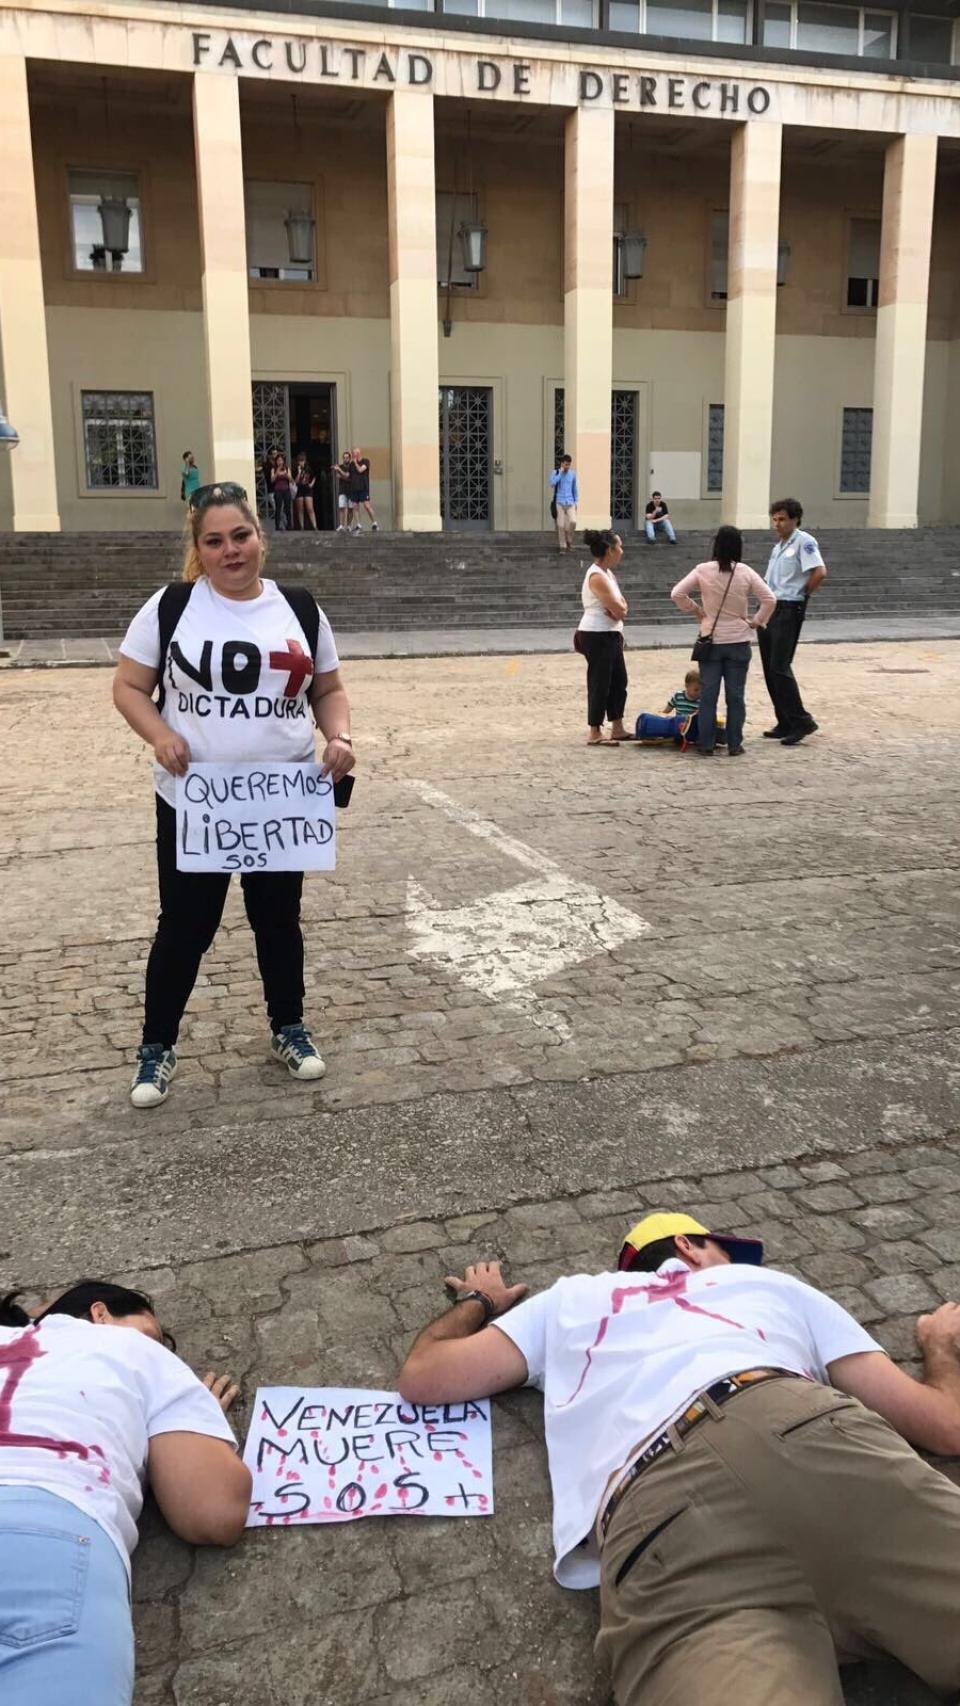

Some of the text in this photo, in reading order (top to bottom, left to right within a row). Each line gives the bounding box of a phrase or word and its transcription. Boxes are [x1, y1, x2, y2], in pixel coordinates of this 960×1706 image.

[191, 32, 772, 115] FACULTAD DE DERECHO
[178, 694, 306, 719] DICTADURA
[184, 769, 333, 809] QUEREMOS
[221, 852, 268, 870] SOS
[262, 1396, 487, 1431] VENEZUELA
[256, 1430, 465, 1471] MUERE
